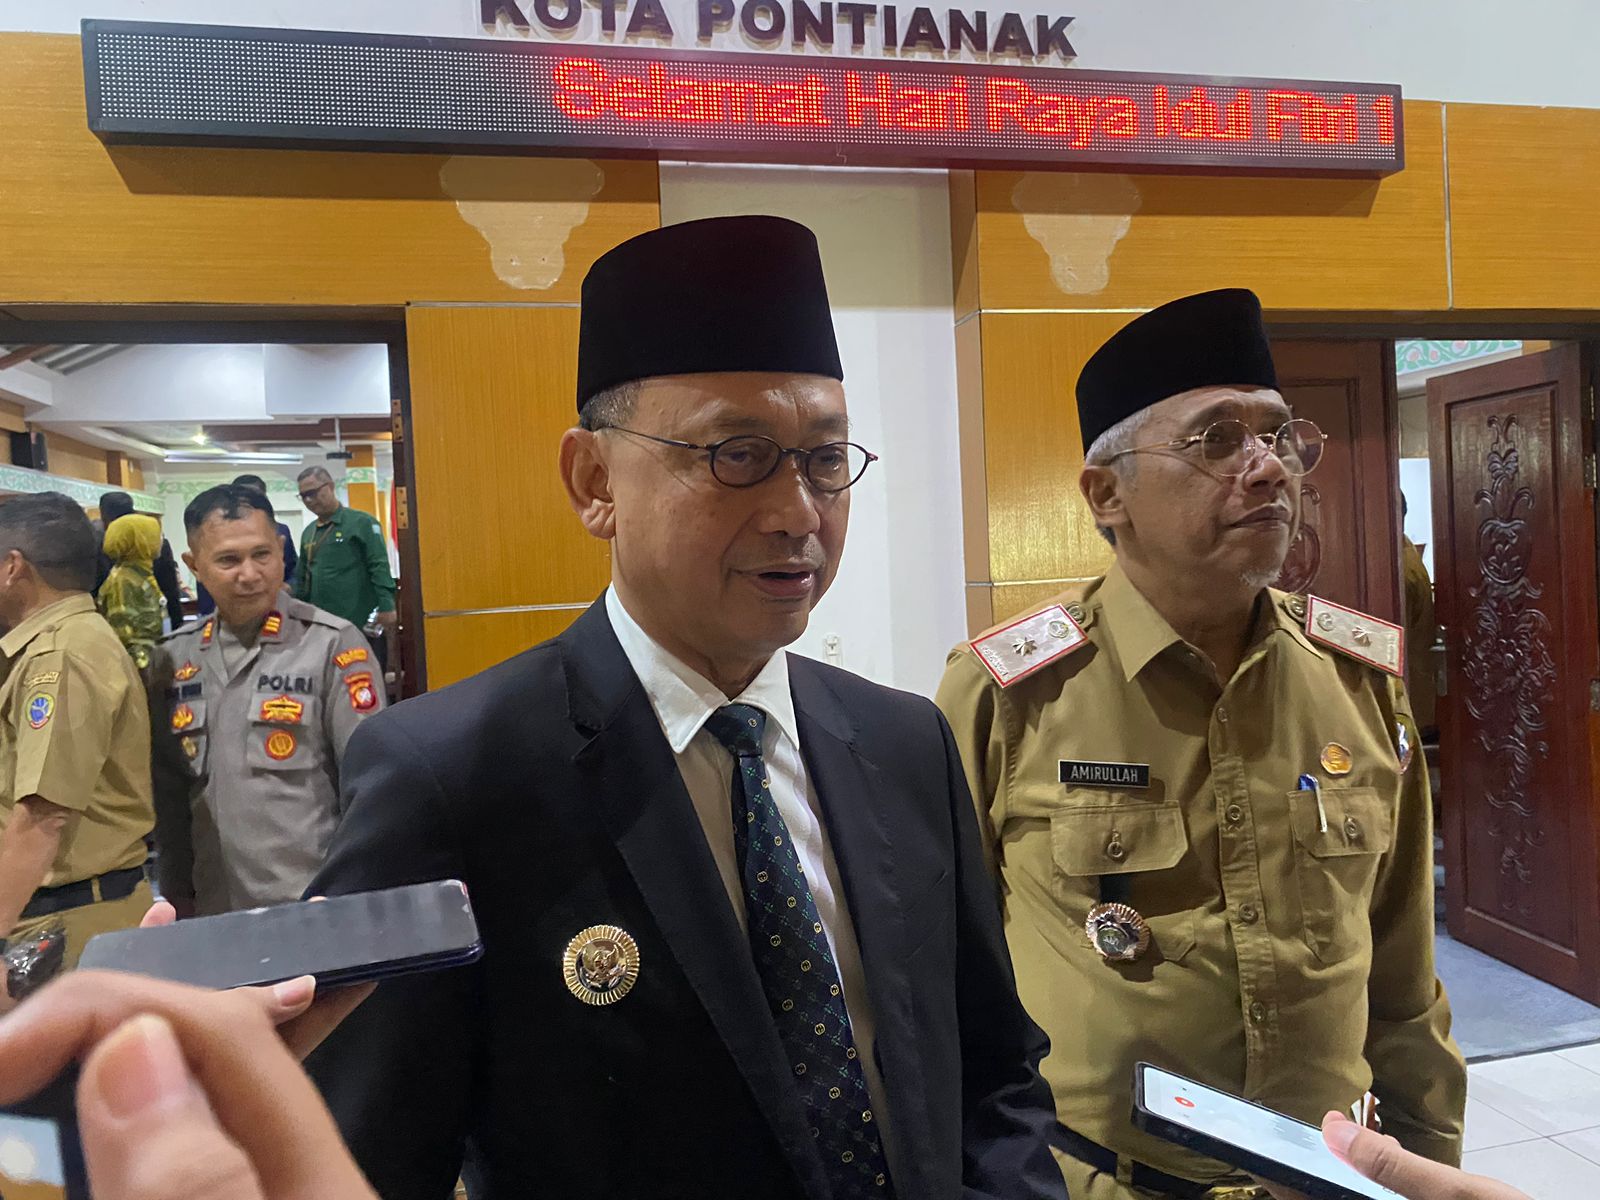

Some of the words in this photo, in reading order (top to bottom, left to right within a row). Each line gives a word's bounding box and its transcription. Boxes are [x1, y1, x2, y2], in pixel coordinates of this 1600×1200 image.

[696, 0, 1078, 58] PONTIANAK
[553, 57, 832, 126] Selamat
[845, 71, 968, 132] Hari
[986, 77, 1139, 149] Raya
[1154, 84, 1251, 142] Idul
[1266, 91, 1357, 145] Fitri
[1371, 95, 1394, 145] 1
[258, 675, 313, 692] POLRI
[1070, 765, 1138, 782] AMIRULLAH
